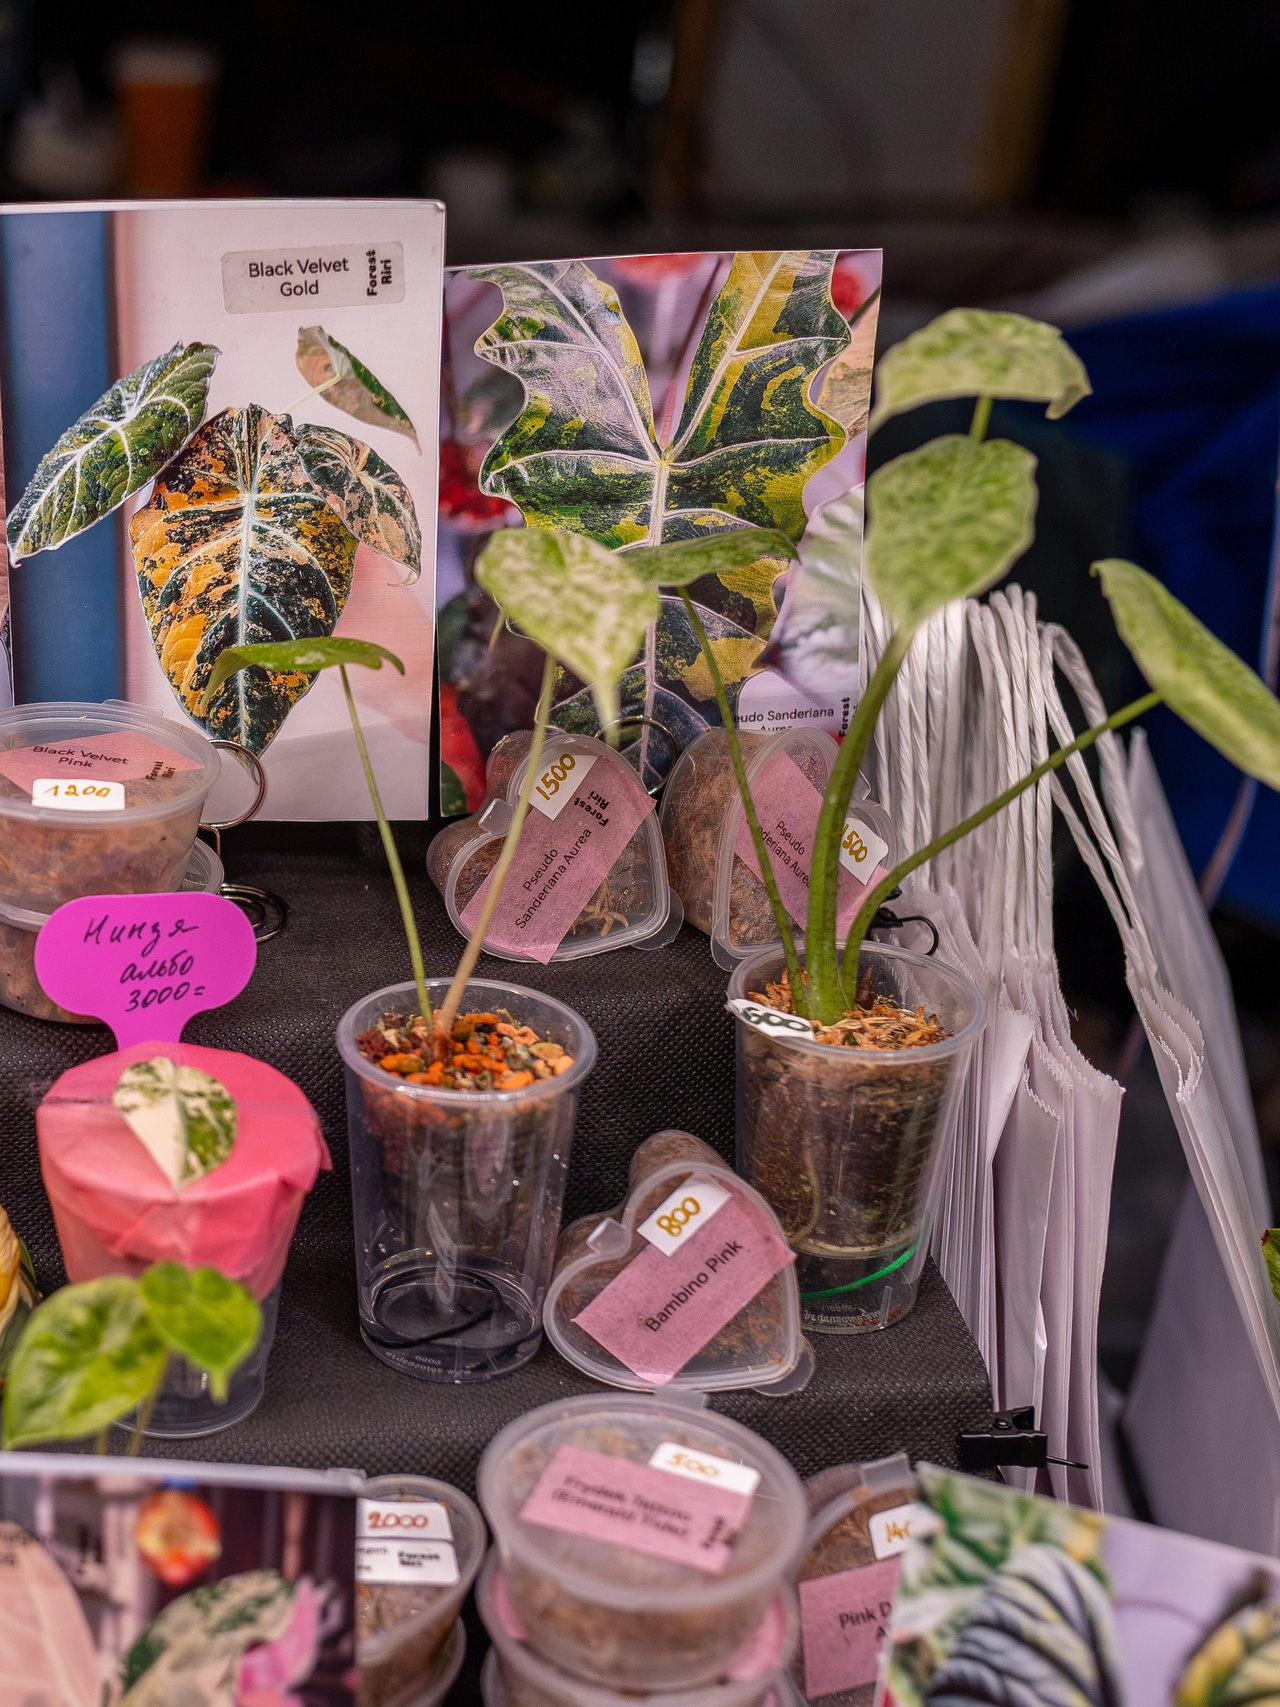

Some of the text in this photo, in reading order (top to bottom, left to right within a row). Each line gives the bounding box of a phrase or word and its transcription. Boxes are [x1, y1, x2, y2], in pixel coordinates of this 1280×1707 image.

[249, 257, 349, 277] Black Velvet
[365, 249, 378, 297] Forest
[380, 259, 392, 285] Riri
[280, 280, 319, 297] Gold
[734, 708, 834, 723] eudo Sanderiana
[33, 745, 130, 765] Black Velvet
[58, 757, 94, 768] Pink
[535, 753, 576, 801] 1500
[45, 784, 111, 798] 1200
[589, 790, 610, 810] Riri
[573, 797, 610, 827] Forest
[775, 820, 805, 856] Pseudo
[841, 823, 868, 863] 1500
[515, 829, 592, 929] Sanderiana Aurea
[523, 848, 559, 892] Pseudo
[120, 949, 194, 984] альбо
[656, 1196, 700, 1237] 800
[644, 1240, 743, 1332] Bambino Pink
[667, 1452, 720, 1477] 500
[368, 1511, 429, 1529] 2000
[838, 1606, 877, 1629] Pink
